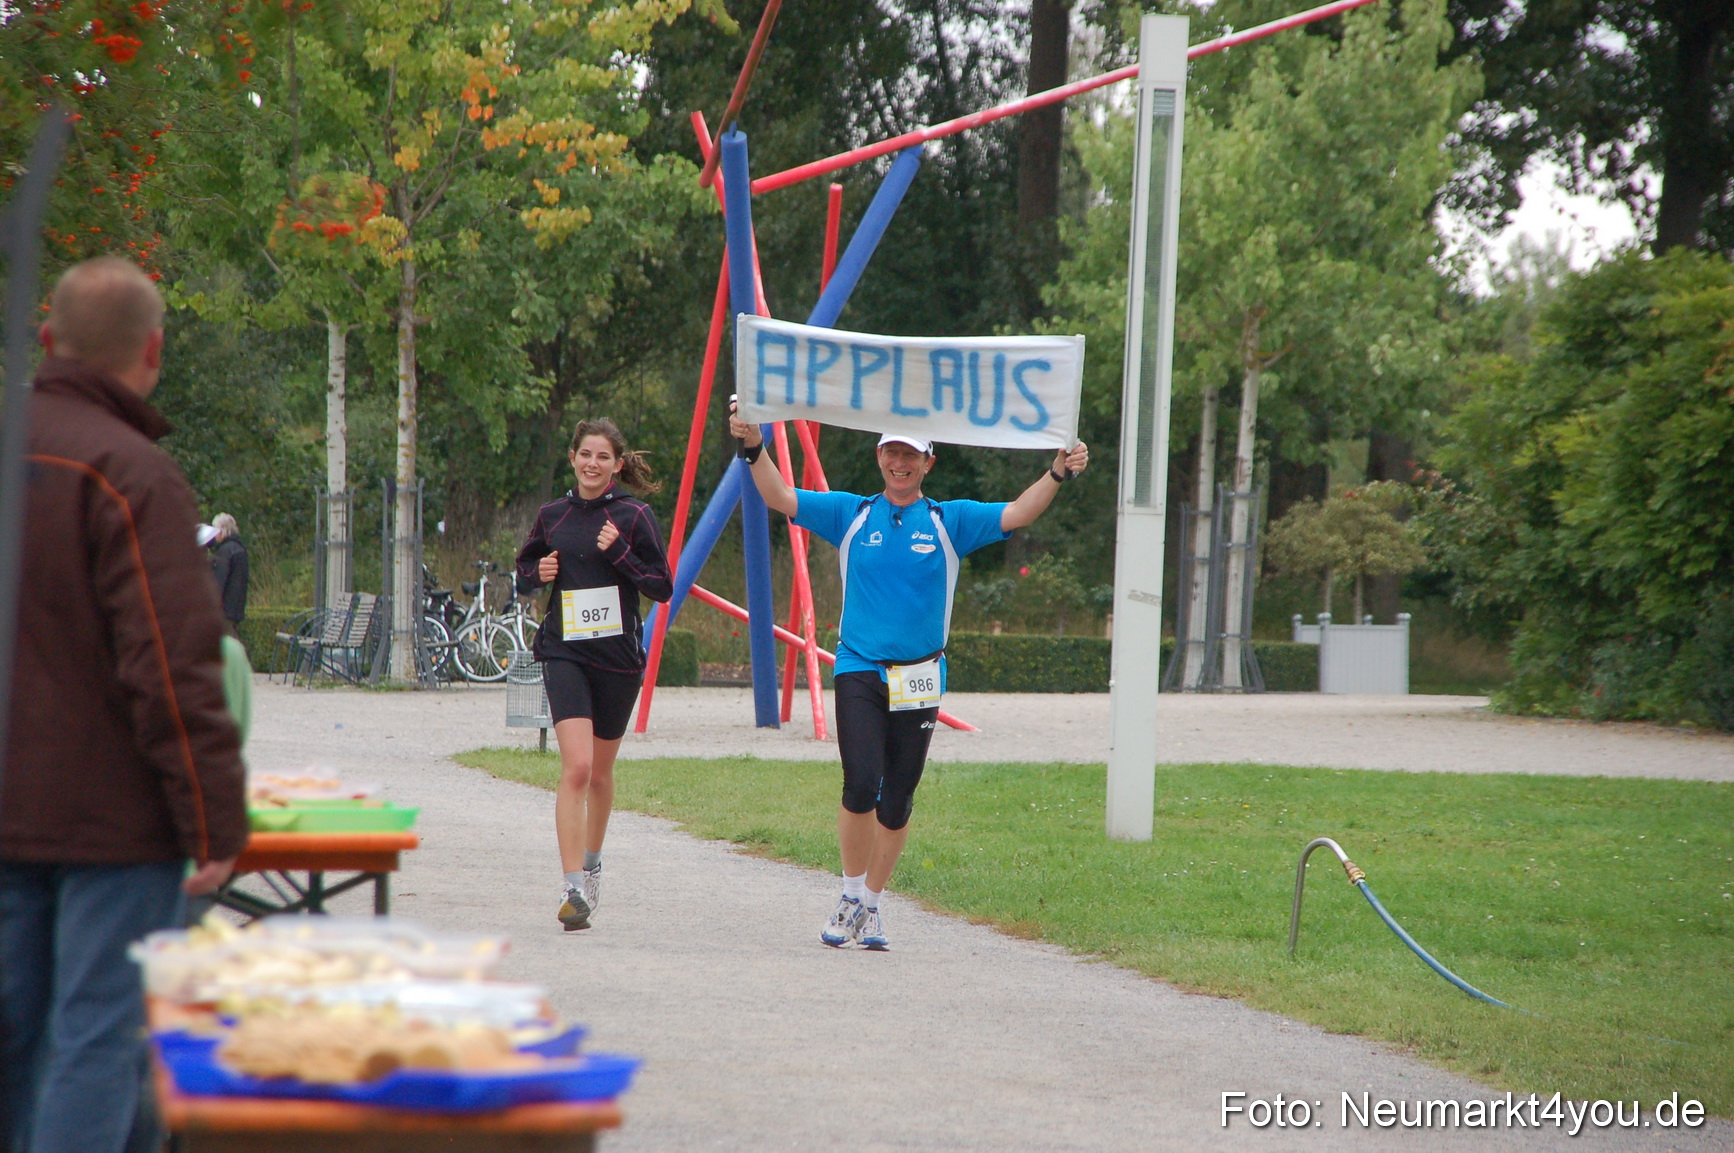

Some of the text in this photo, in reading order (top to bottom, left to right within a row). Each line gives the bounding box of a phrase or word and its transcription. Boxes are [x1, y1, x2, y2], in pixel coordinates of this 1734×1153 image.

[755, 329, 1051, 432] APPLAUS
[581, 606, 610, 623] 987
[909, 678, 934, 693] 986
